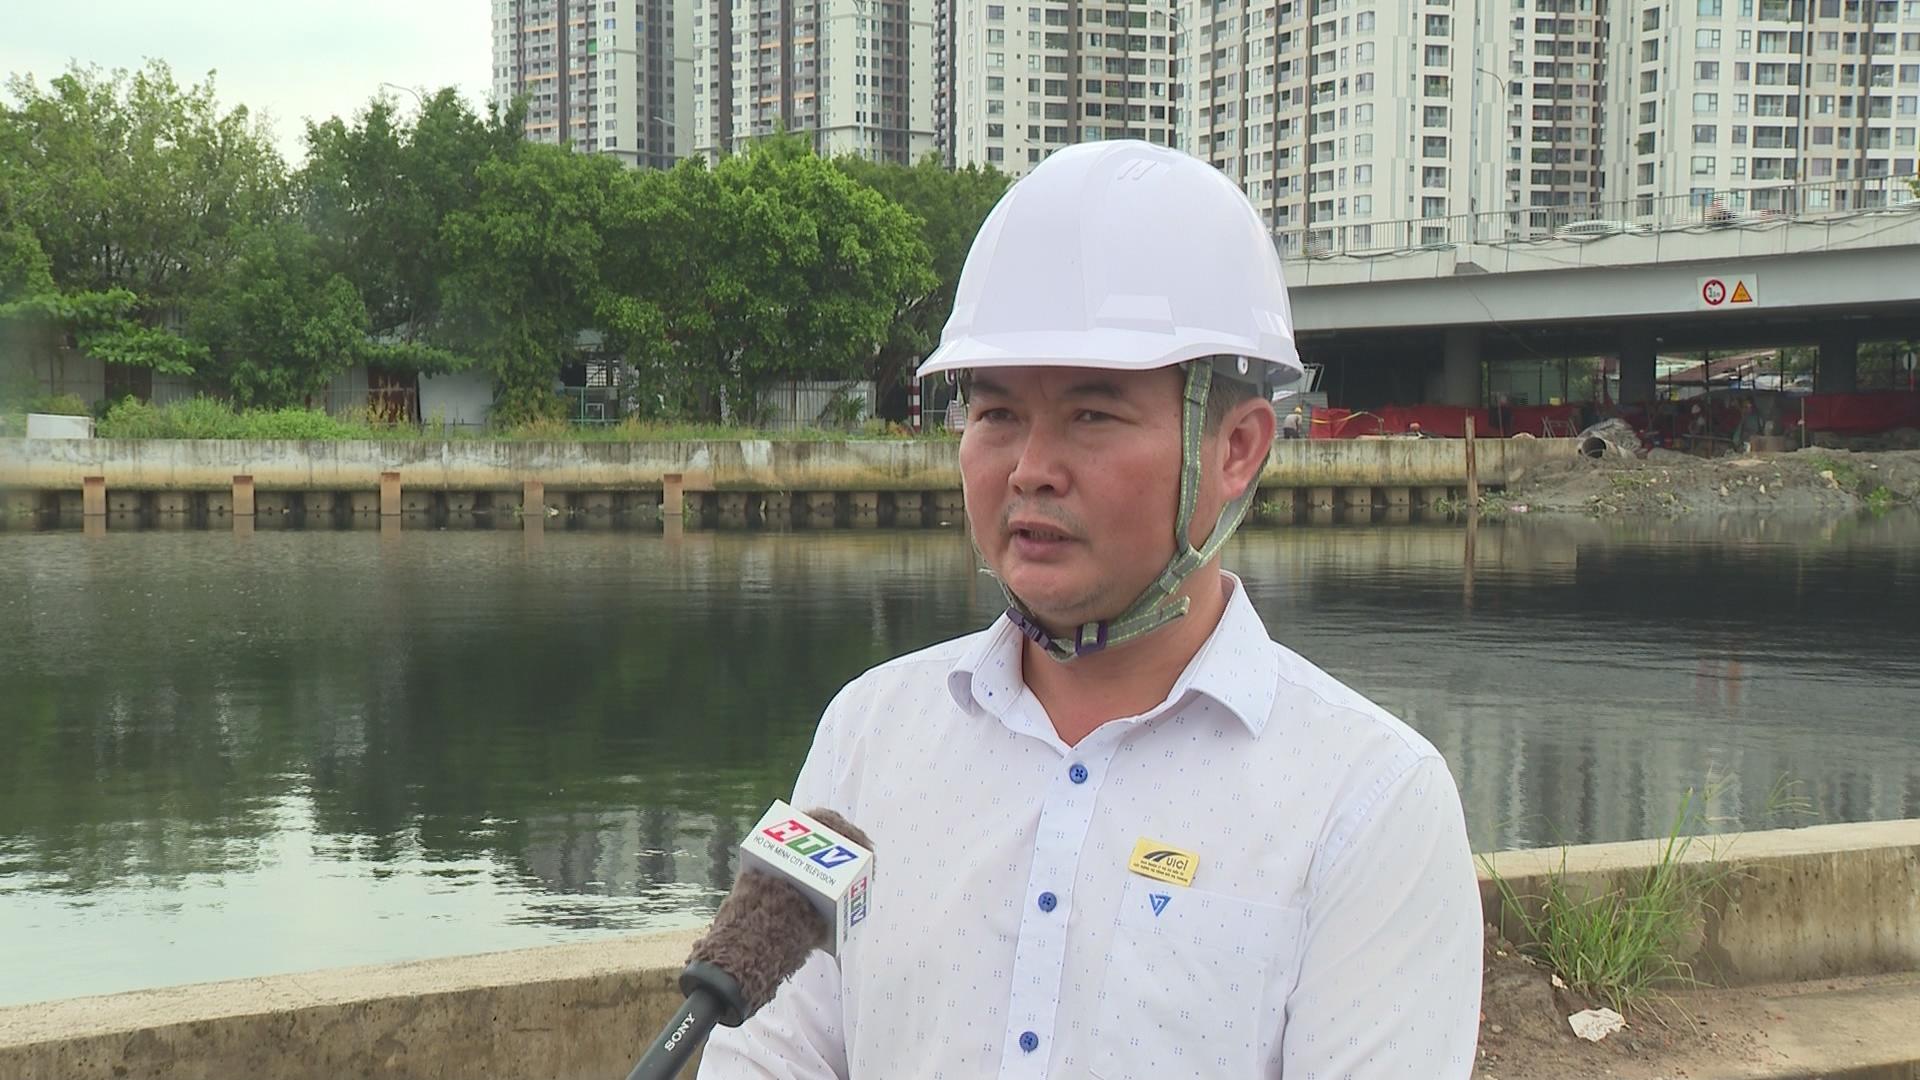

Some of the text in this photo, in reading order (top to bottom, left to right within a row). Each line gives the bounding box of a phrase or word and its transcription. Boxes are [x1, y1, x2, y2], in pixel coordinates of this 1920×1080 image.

[762, 819, 859, 869] HTV
[774, 844, 791, 859] MINH
[789, 854, 803, 868] CITY
[802, 860, 837, 887] TELEVISION
[850, 876, 867, 928] HTV
[664, 1012, 696, 1052] SONY
